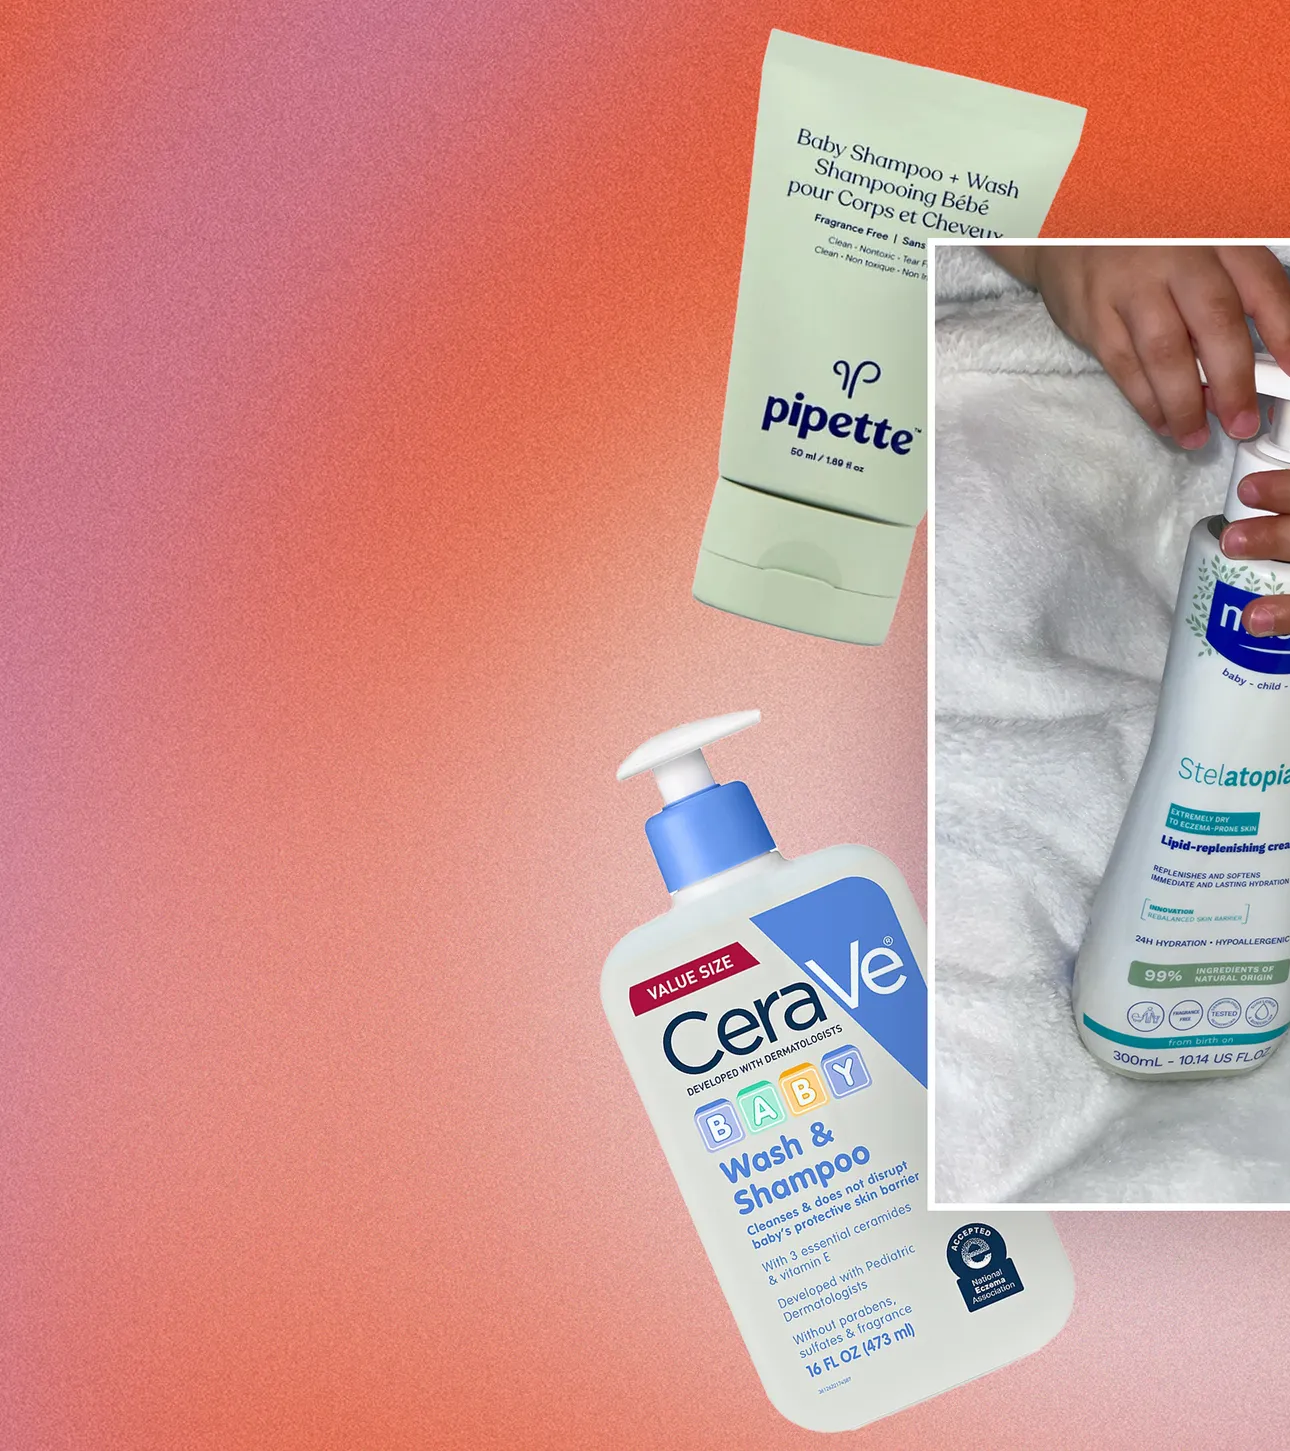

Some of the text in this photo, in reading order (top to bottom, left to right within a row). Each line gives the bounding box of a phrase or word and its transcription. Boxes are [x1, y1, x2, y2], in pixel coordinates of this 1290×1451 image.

[797, 128, 846, 158] Baby
[850, 145, 943, 182] Shampoo
[967, 172, 1019, 198] Wash
[815, 158, 988, 215] Shampooing Bébé
[787, 180, 834, 201] pour
[838, 190, 894, 220] Corps
[899, 209, 916, 224] et
[815, 214, 864, 234] Fragrance
[866, 228, 888, 240] Free
[902, 236, 926, 249] Sans
[814, 246, 838, 258] Clean
[845, 254, 863, 264] Non
[865, 260, 895, 273] toxique
[902, 268, 919, 279] Non
[828, 236, 852, 249] Clean
[860, 245, 895, 260] Nontoxic
[904, 255, 919, 265] Tear
[791, 448, 803, 457] 50
[805, 452, 817, 461] ml
[827, 456, 843, 467] 1.89
[854, 464, 864, 473] oz
[1222, 668, 1246, 686] baby
[1257, 682, 1281, 690] child
[1169, 817, 1178, 826] TO
[1180, 820, 1239, 832] ECZEMA-PRONE
[1171, 809, 1214, 823] EXTREMELY
[1161, 835, 1266, 855] Lipid-replenishing
[1151, 874, 1195, 888] IMMEDIATE
[1215, 880, 1246, 888] LASTING
[1249, 878, 1290, 887] HYDRATION
[1153, 865, 1206, 880] REPLENISHES
[1148, 912, 1195, 922] REBALANCED
[1150, 904, 1194, 914] INNOVATION
[1135, 935, 1153, 945] 24H
[1215, 935, 1290, 945] HYPOALLERGENIC
[646, 954, 734, 1000] VALUE SIZE
[1145, 969, 1183, 982] 99%
[1195, 974, 1237, 983] NATURAL
[1196, 966, 1259, 974] INGREDIENTS
[1169, 1038, 1192, 1046] from
[1196, 1037, 1218, 1045] birth
[687, 1025, 842, 1096] DEVELOPED WITH DERMATOLOGISTS
[1113, 1050, 1162, 1067] 300mL
[1179, 1054, 1209, 1065] 10.14
[1214, 1052, 1232, 1063] US
[719, 1122, 834, 1183] Wash &
[734, 1146, 870, 1215] Shampoo
[747, 1161, 908, 1236] Cleanses & does not disrupt
[794, 1201, 852, 1235] protective
[854, 1191, 877, 1207] skin
[880, 1172, 920, 1195] barrier
[762, 1203, 912, 1272] With 3 essential ceramides
[951, 1227, 991, 1251] ACCEPTED
[778, 1244, 916, 1309] Developed with Pediatric
[781, 1256, 821, 1281] vitamin
[823, 1252, 831, 1262] E
[972, 1269, 1002, 1286] National
[973, 1282, 1015, 1304] Association
[975, 1278, 1005, 1294] Eczema
[783, 1280, 868, 1322] Dermatologists
[793, 1297, 896, 1345] Without parabens,
[799, 1304, 912, 1359] sulfates & fragrance
[806, 1323, 915, 1377] 16 FL OZ (473 ml)
